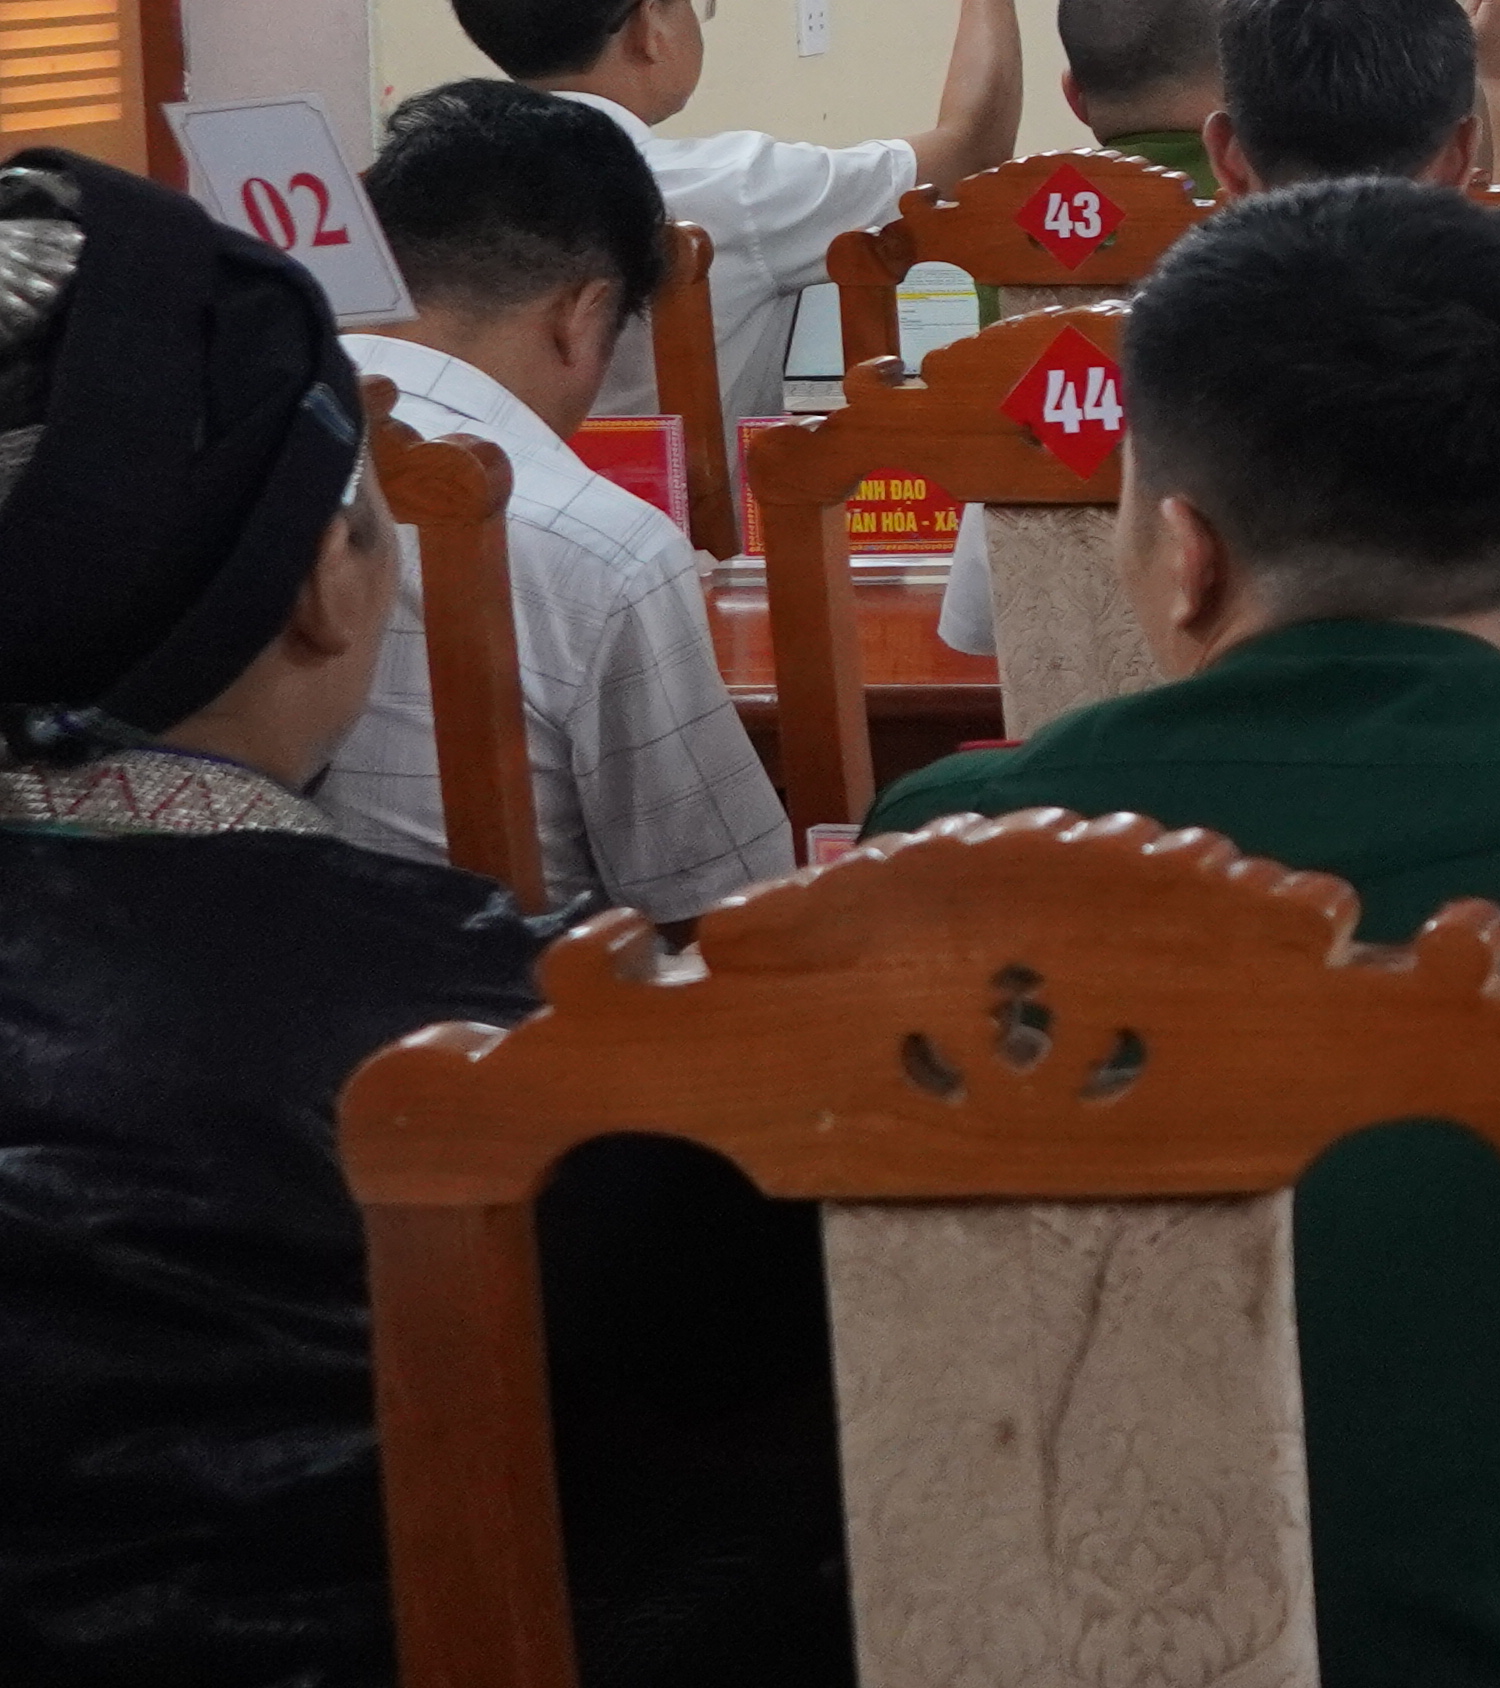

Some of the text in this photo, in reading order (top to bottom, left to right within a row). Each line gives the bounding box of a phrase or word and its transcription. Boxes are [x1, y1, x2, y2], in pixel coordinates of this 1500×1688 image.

[241, 172, 350, 252] 02
[1044, 191, 1103, 240] 43
[1043, 366, 1123, 433] 44
[890, 479, 926, 504] ĐẠO
[882, 506, 918, 533] HÓA
